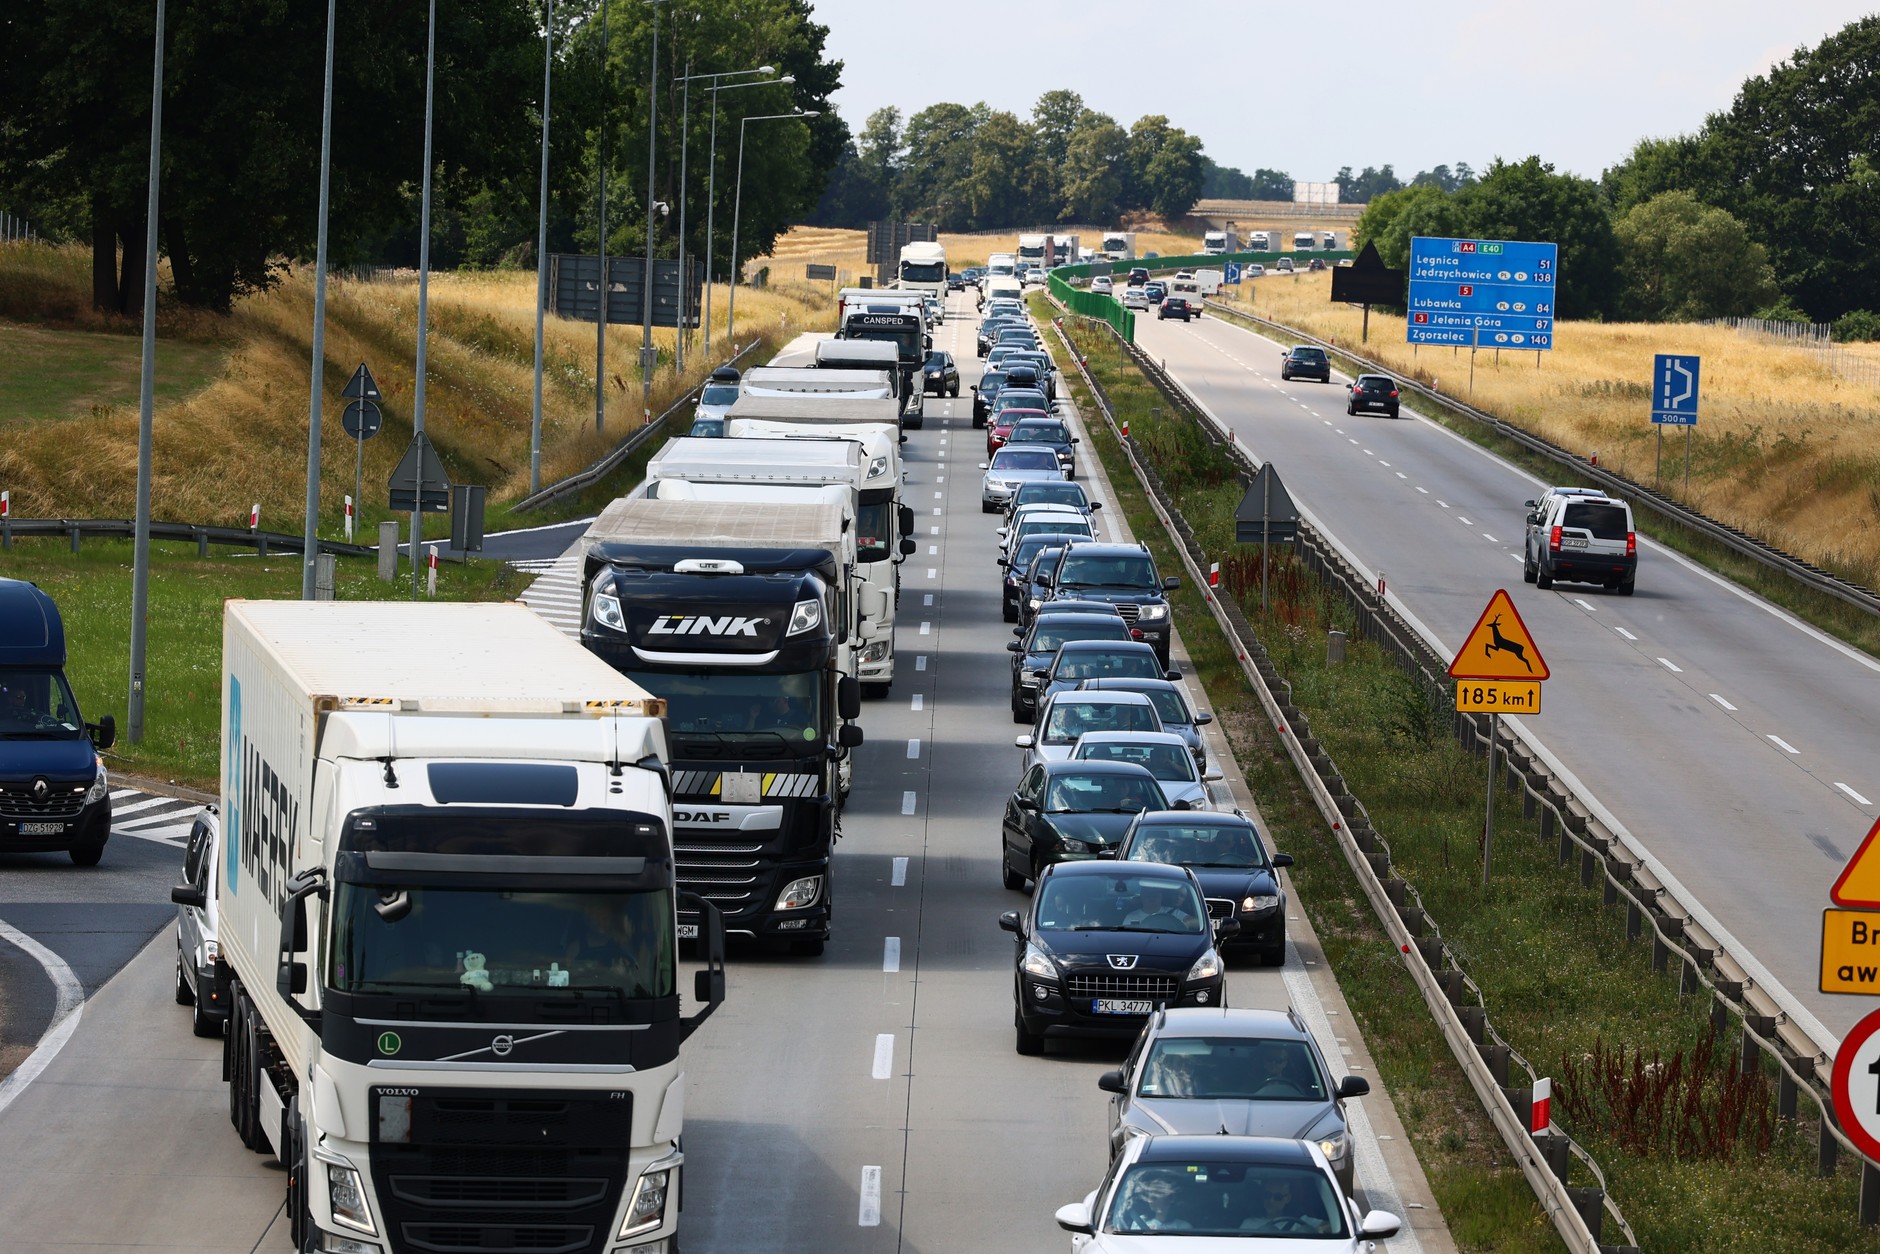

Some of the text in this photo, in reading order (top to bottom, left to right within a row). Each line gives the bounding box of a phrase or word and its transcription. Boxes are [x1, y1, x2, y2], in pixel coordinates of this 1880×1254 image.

[1462, 244, 1499, 253] A4 E40
[1416, 254, 1551, 269] Legnica 51
[1415, 267, 1492, 280] Jędrzychowice
[1534, 273, 1551, 282] 138
[1463, 287, 1469, 295] 5
[1414, 297, 1462, 309] Lubawka
[1536, 303, 1550, 313] 84
[863, 316, 904, 325] CANSPED
[1418, 314, 1548, 329] 3 Jelenia Góra 87
[1412, 329, 1465, 341] Zgorzelec
[1530, 335, 1548, 345] 140
[1662, 414, 1679, 423] 500
[1472, 687, 1525, 706] 85 km
[673, 811, 730, 823] DAF
[23, 823, 38, 833] DZG
[1098, 1000, 1152, 1012] PKL 34777
[385, 1036, 395, 1051] L
[376, 1087, 419, 1096] VOLVO
